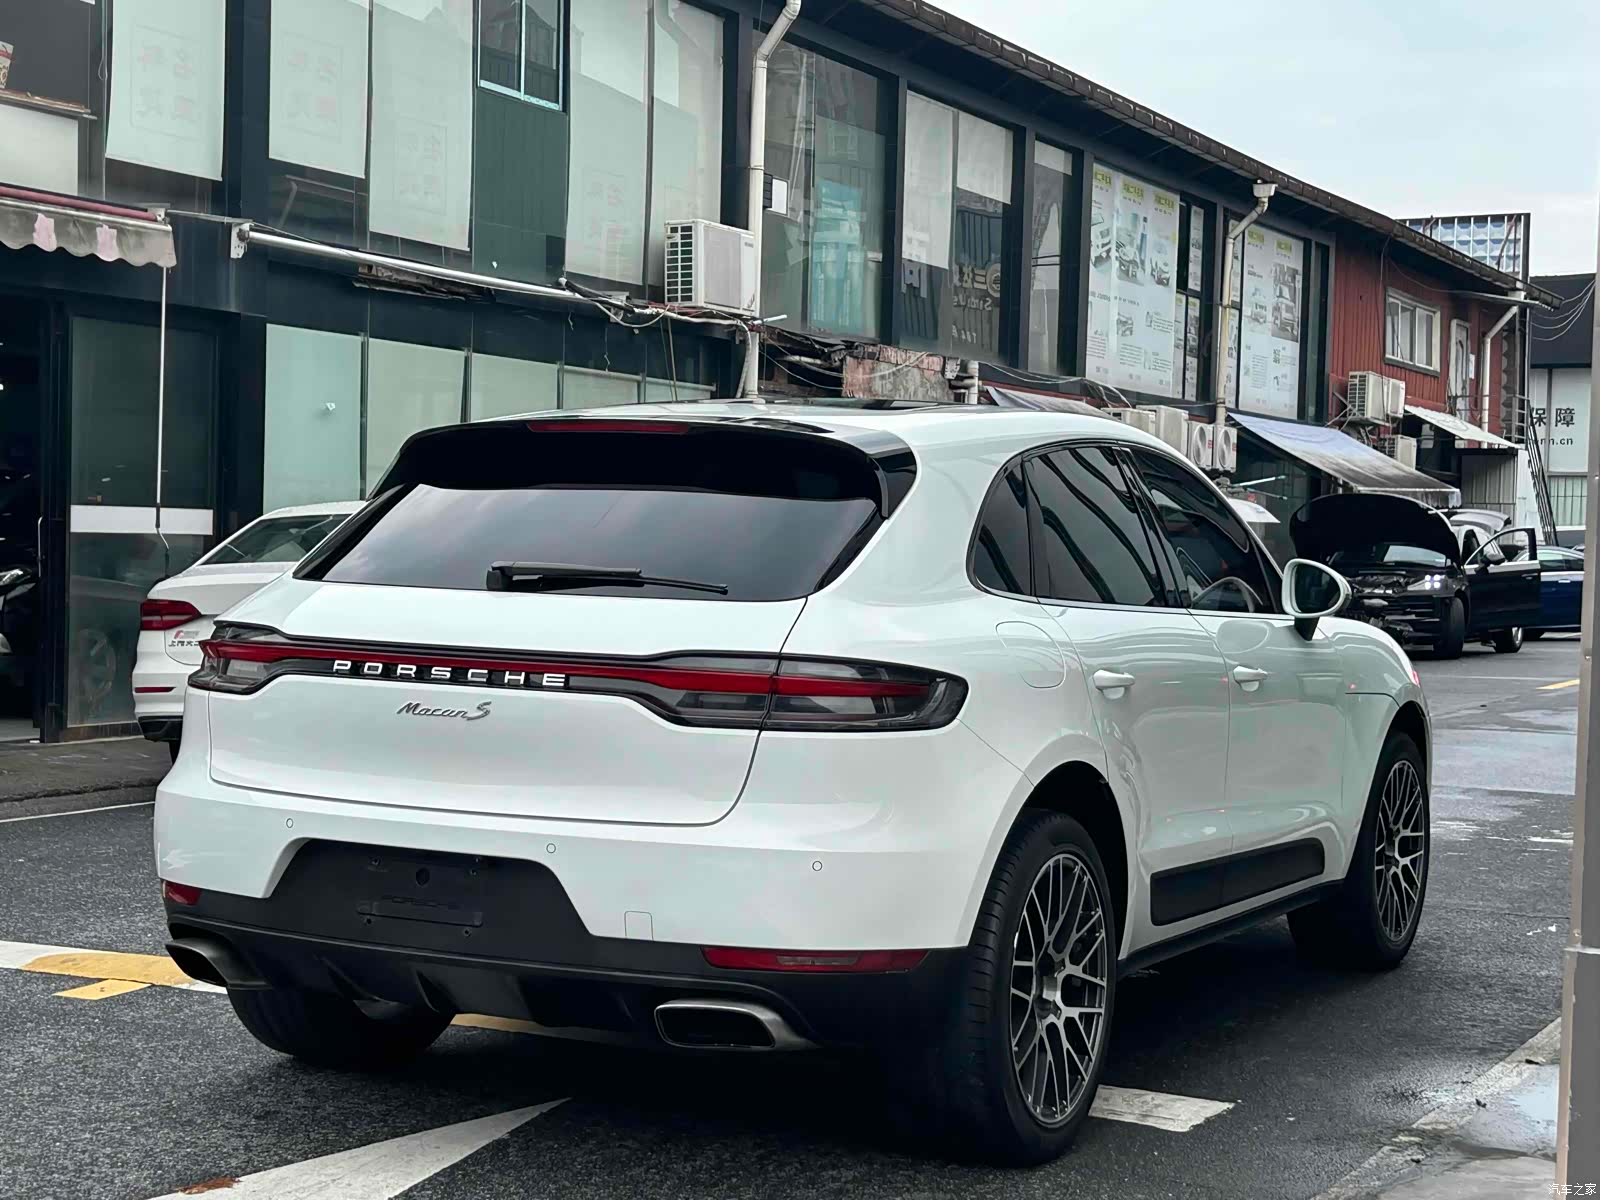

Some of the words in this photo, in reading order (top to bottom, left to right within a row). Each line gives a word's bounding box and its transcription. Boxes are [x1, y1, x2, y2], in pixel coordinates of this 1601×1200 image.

[1531, 407, 1575, 427] 保障
[332, 659, 567, 687] PORSCHE
[396, 701, 468, 719] Macan
[466, 701, 492, 721] S
